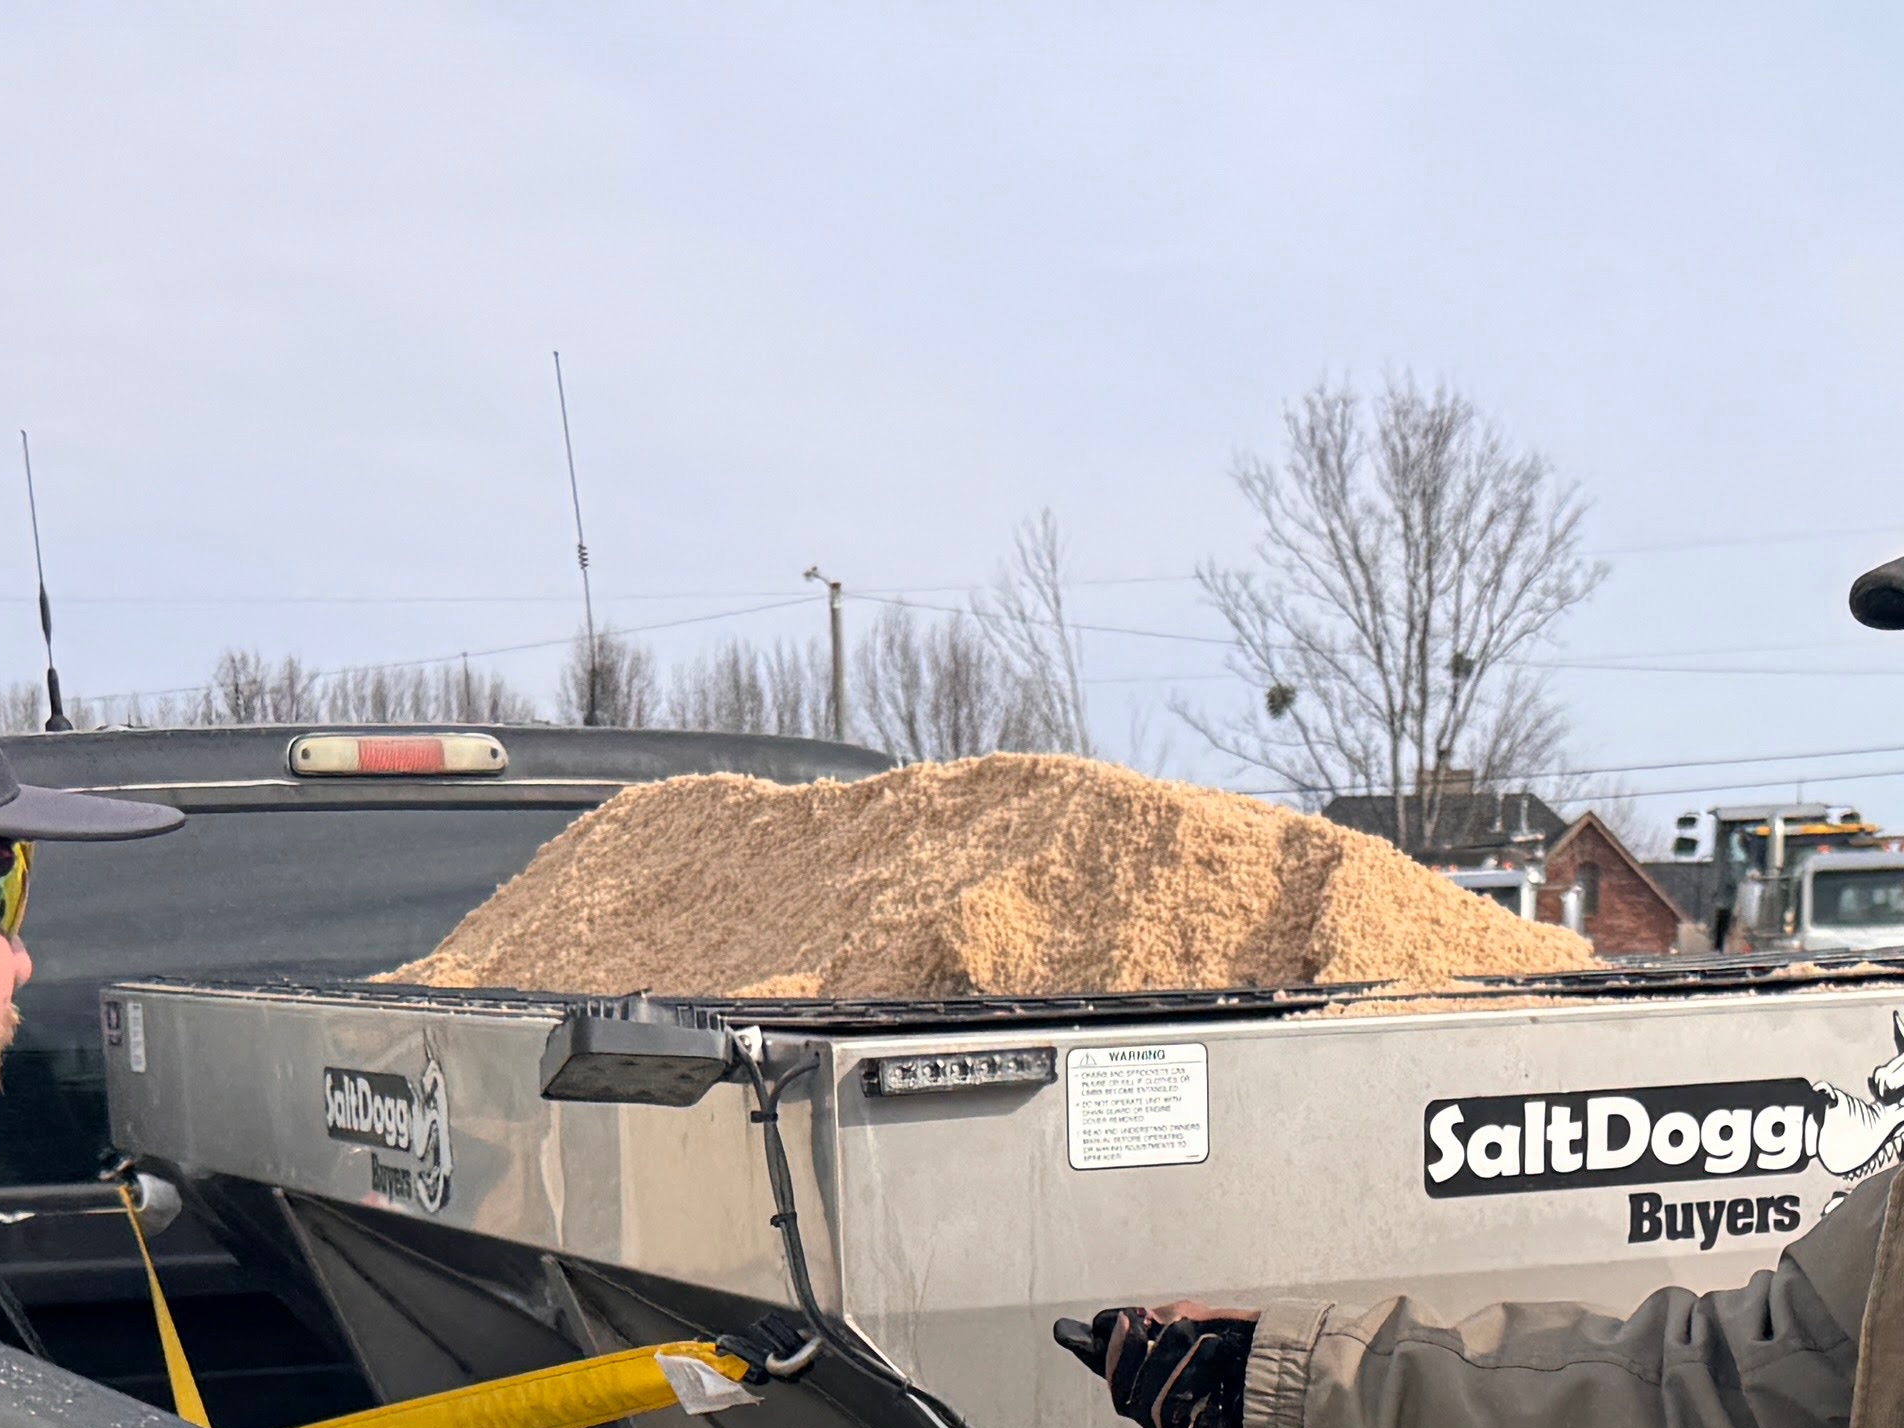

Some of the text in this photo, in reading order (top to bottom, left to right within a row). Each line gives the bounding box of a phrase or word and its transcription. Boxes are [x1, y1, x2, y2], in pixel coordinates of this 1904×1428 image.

[1109, 1049, 1166, 1062] WARNING
[325, 1073, 410, 1149] SaltDogg
[1427, 1096, 1806, 1184] SaltDogg
[1628, 1191, 1801, 1251] Buyers
